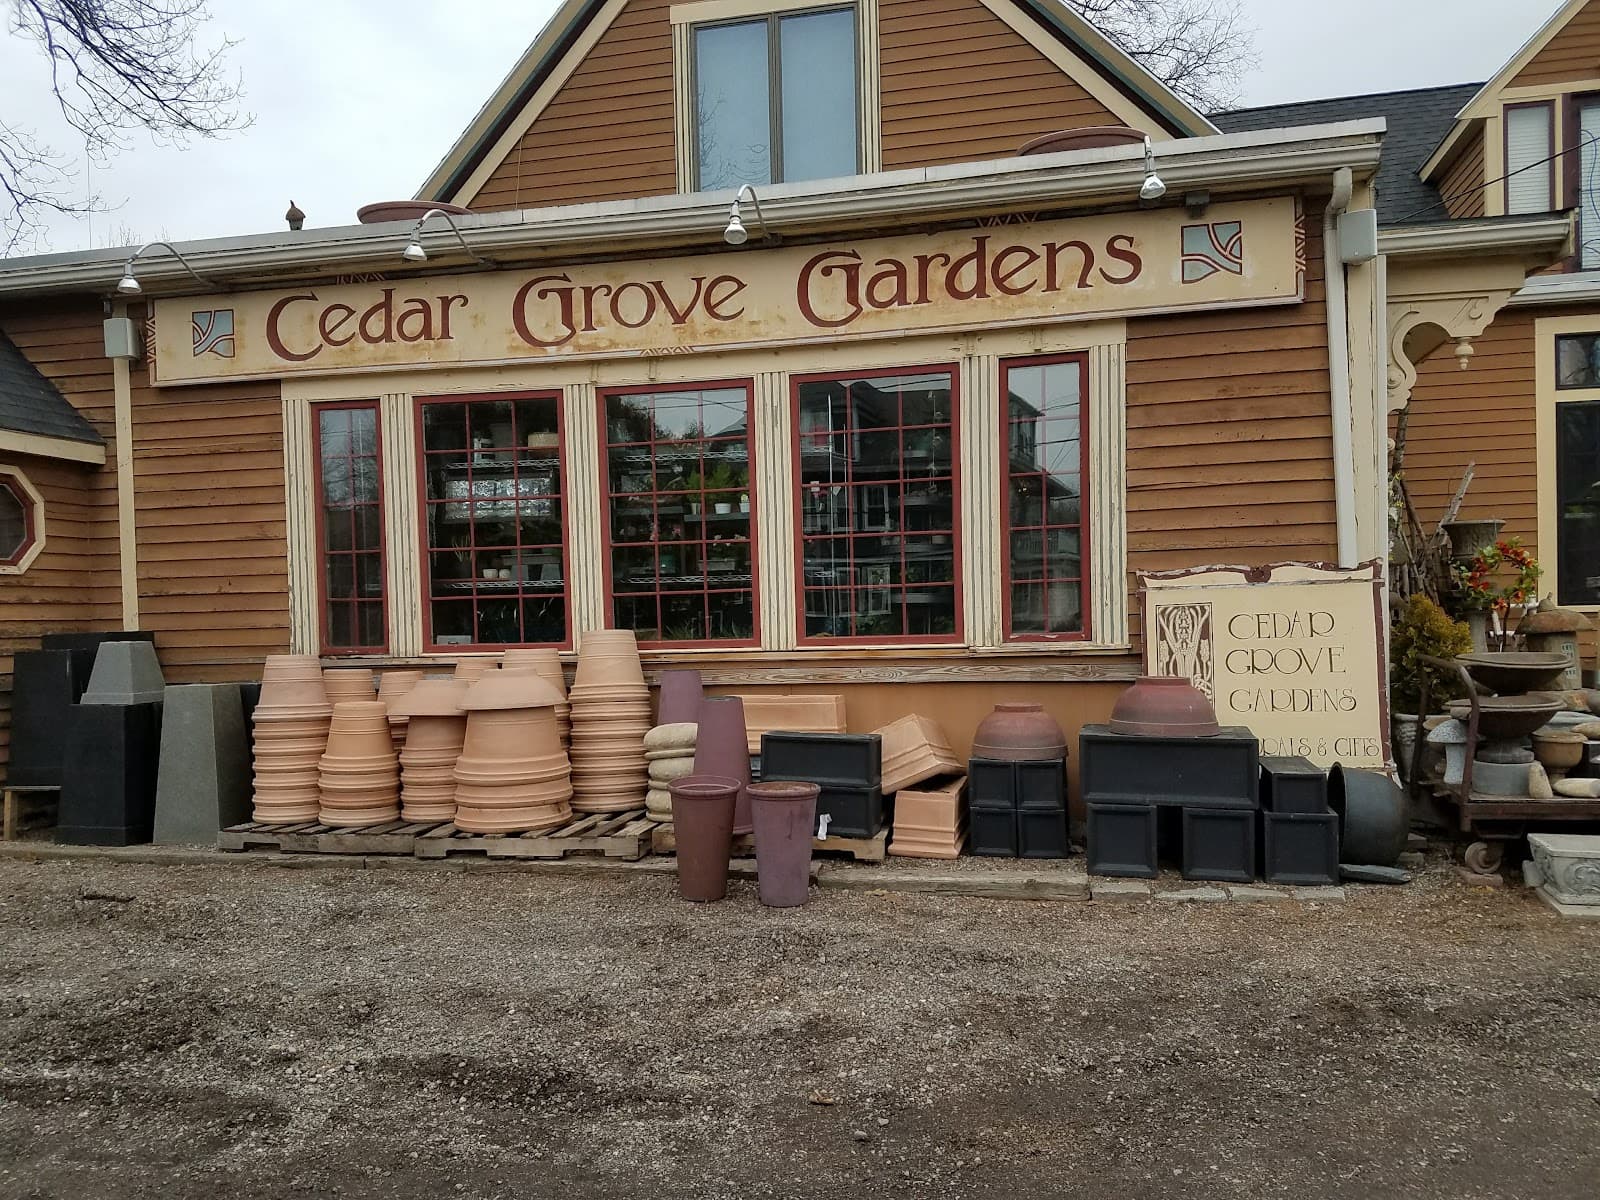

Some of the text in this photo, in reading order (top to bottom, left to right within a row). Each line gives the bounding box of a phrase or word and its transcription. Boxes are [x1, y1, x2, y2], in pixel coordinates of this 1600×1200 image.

[265, 233, 1143, 362] Cedar Grove Gardens
[1227, 609, 1335, 640] CEDAR
[1225, 645, 1346, 675] GROVE
[1229, 687, 1357, 713] GARDENS
[1259, 736, 1380, 757] RALS & GIFTS
